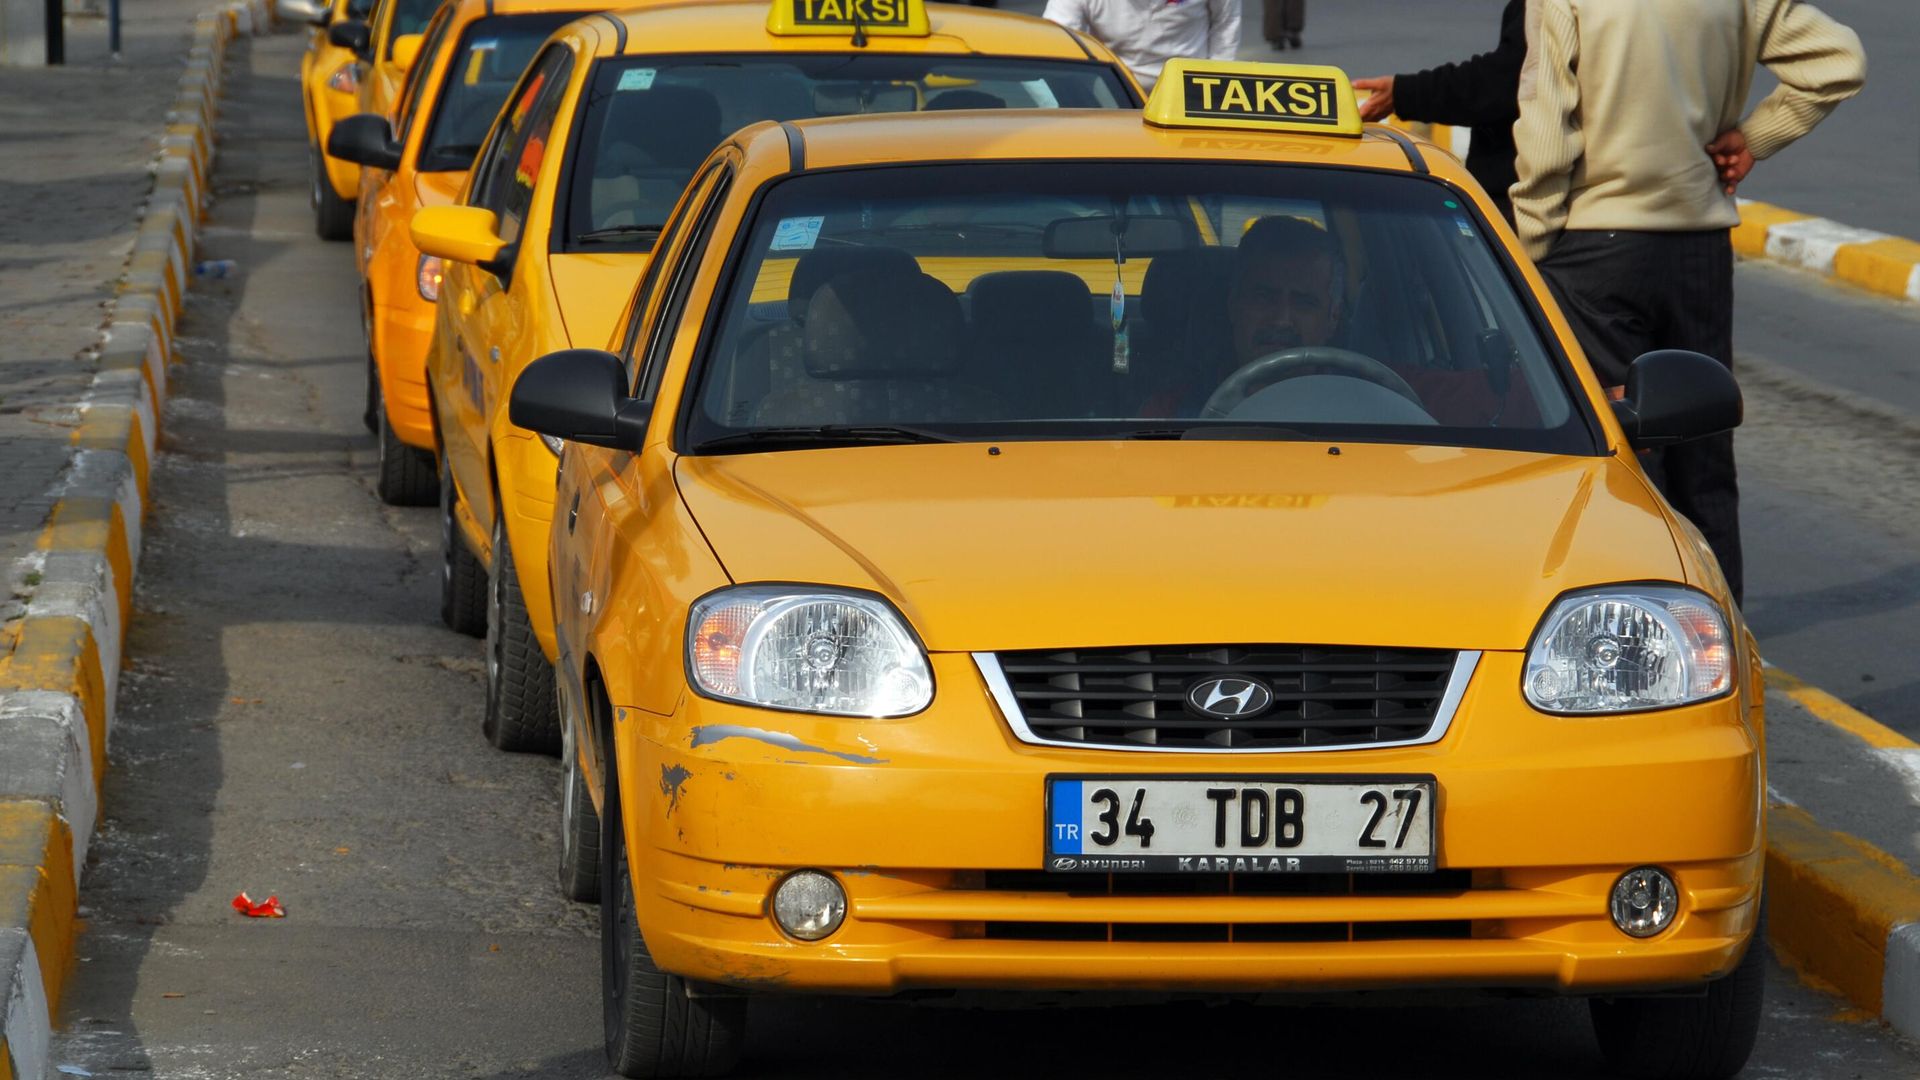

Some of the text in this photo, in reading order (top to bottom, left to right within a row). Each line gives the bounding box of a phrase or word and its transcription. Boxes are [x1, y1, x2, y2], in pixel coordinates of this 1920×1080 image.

[1090, 788, 1422, 848] 34 TDB 27
[1055, 823, 1079, 840] TR
[1178, 857, 1300, 872] KARALAR
